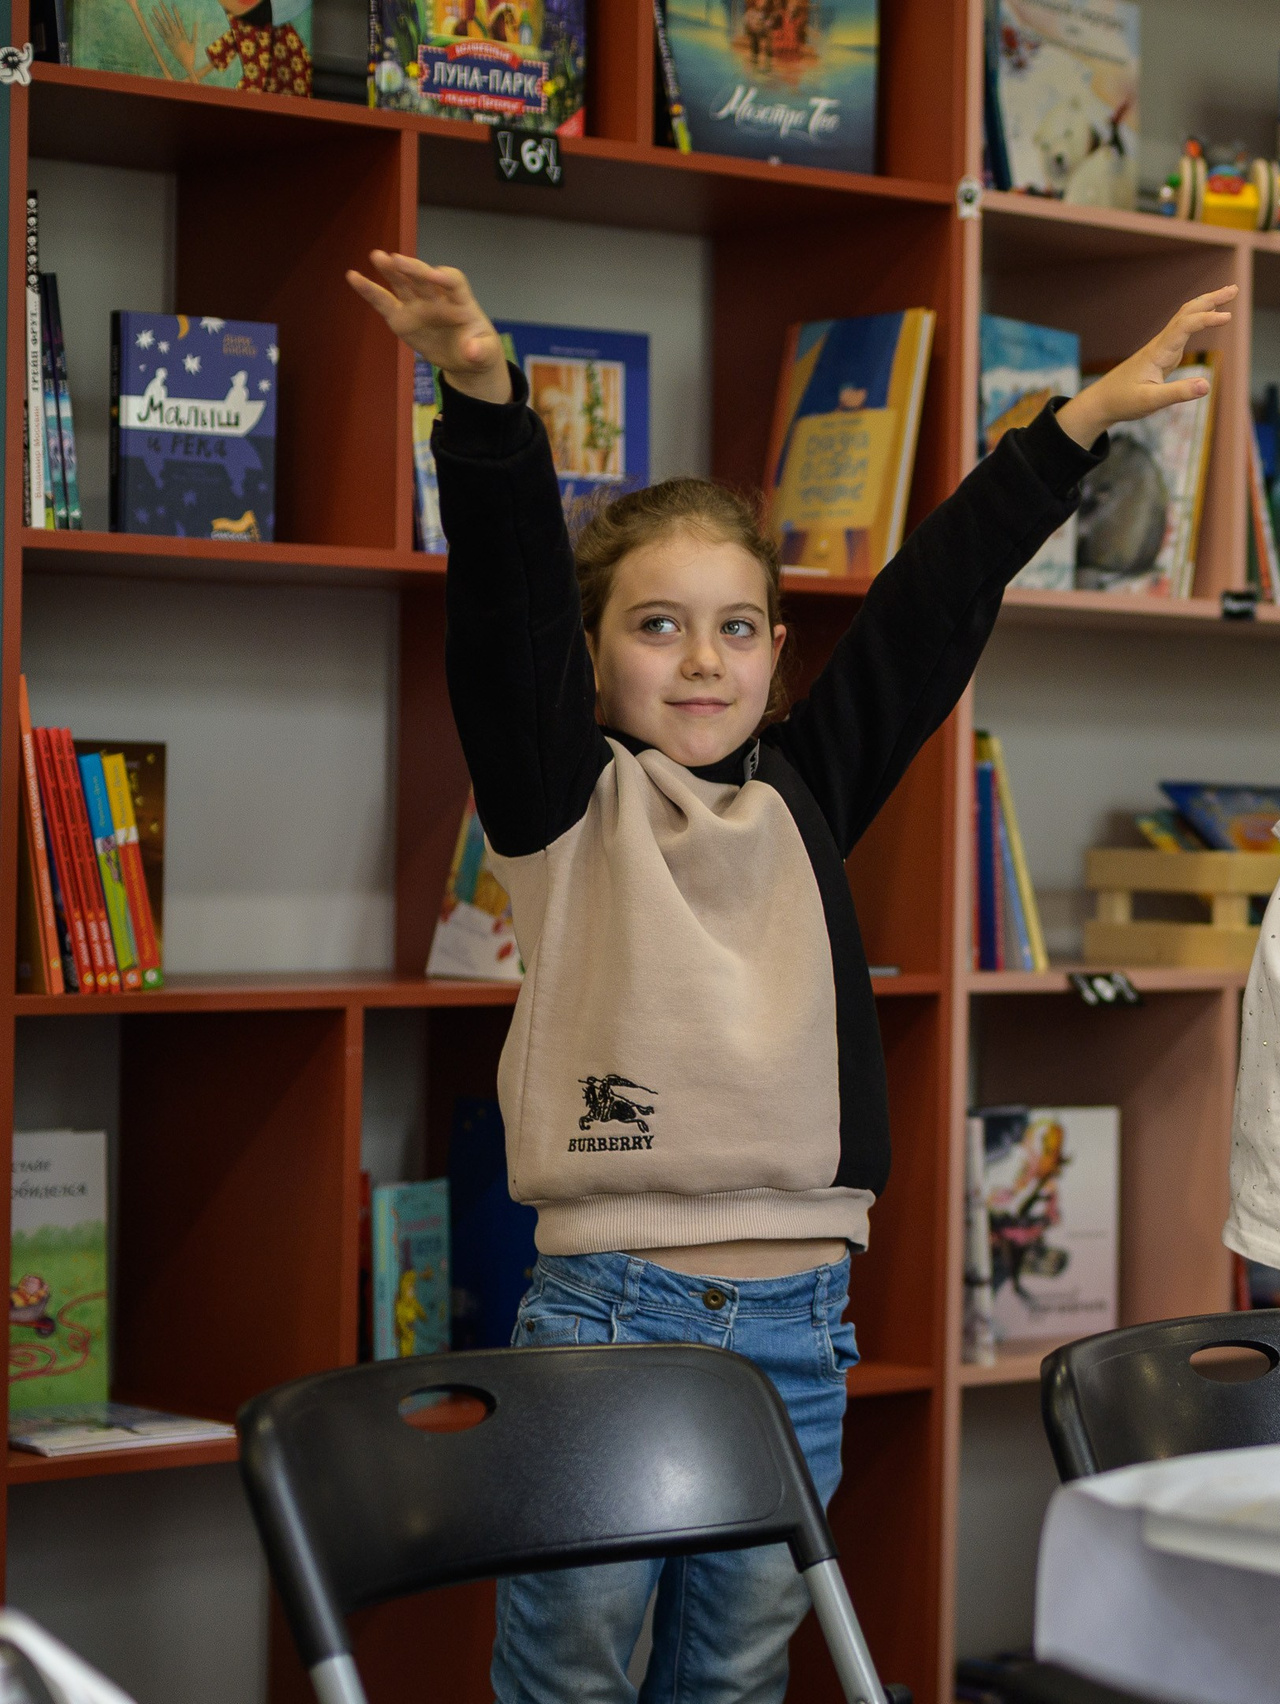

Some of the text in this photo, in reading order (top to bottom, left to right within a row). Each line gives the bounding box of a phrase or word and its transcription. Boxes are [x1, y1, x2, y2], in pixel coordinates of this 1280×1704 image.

[432, 61, 538, 98] ЛУНА-ПАРК
[137, 396, 241, 428] Малыш
[567, 1135, 655, 1152] BURBERRY
